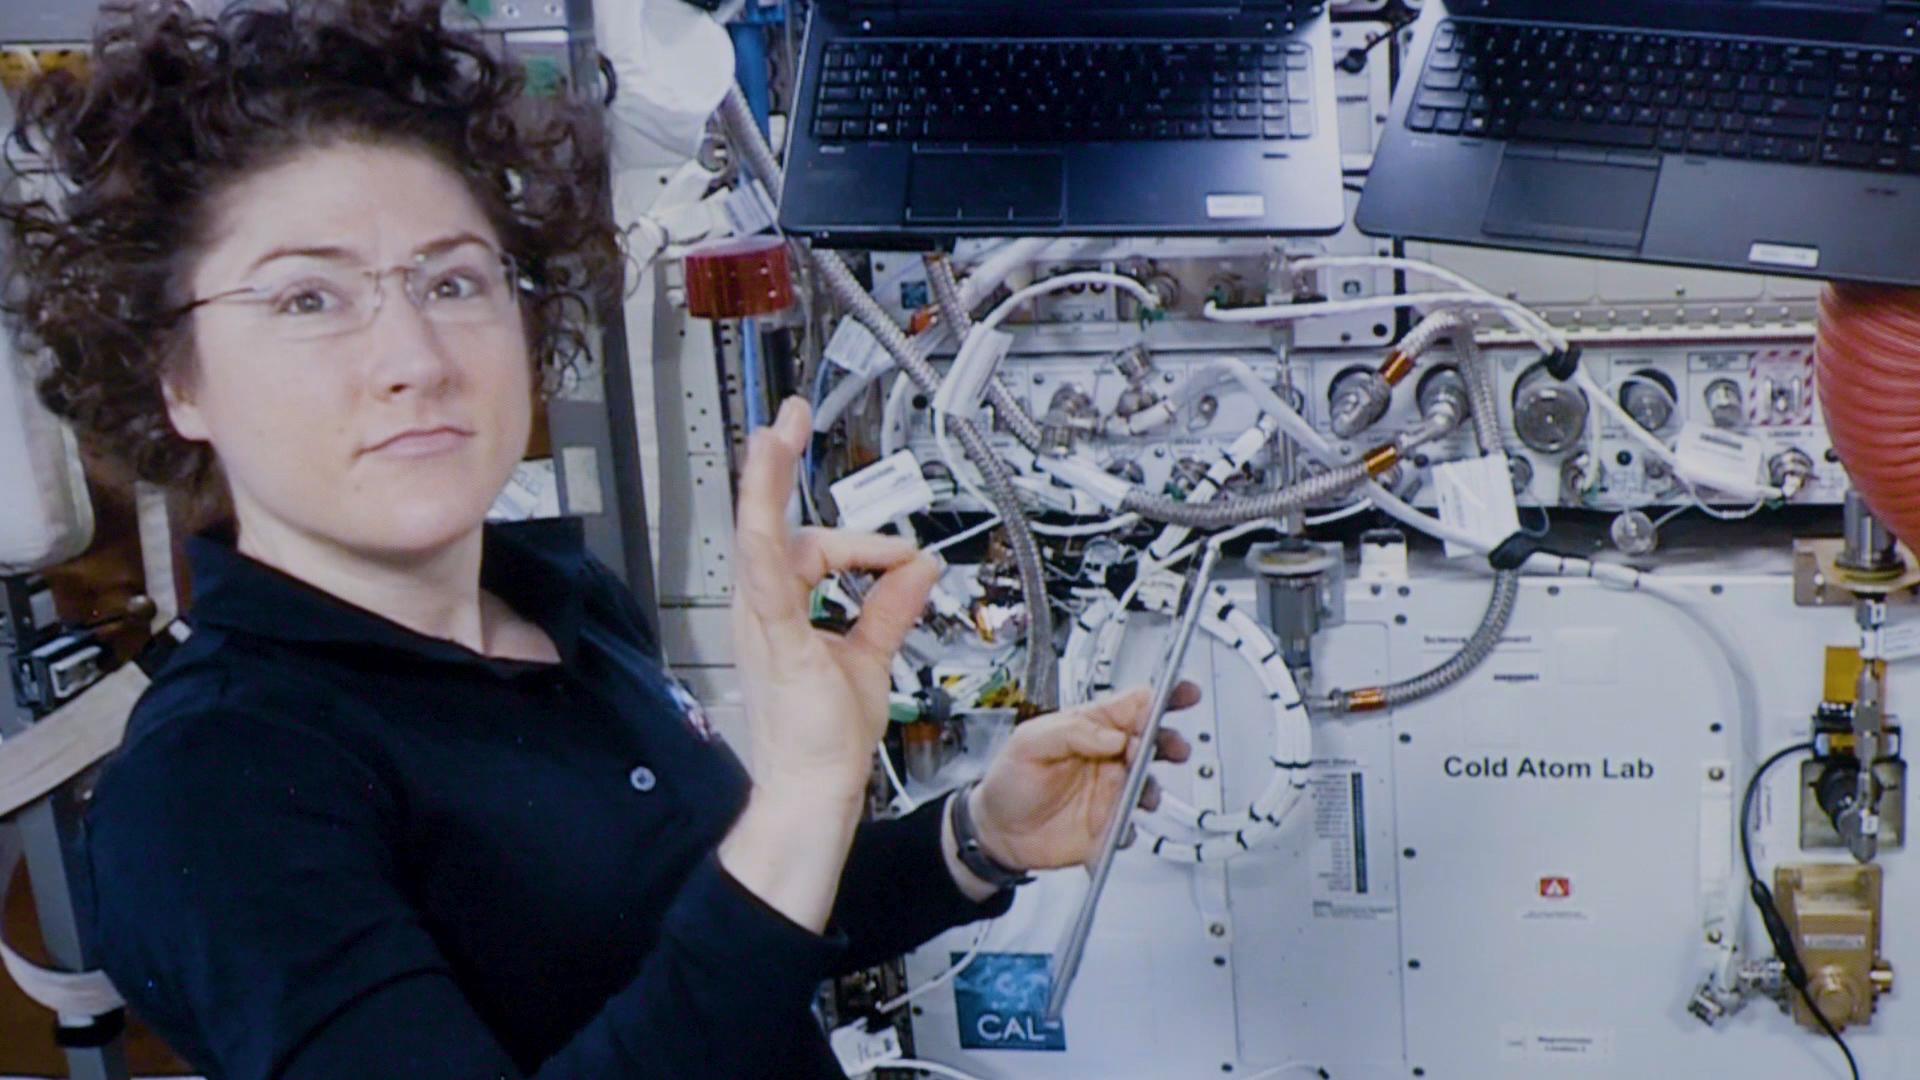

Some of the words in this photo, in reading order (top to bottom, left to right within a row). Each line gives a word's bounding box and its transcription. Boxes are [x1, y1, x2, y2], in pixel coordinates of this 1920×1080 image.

[1443, 755, 1508, 777] Cold
[1516, 757, 1591, 779] Atom
[1602, 758, 1654, 779] Lab
[977, 1013, 1046, 1041] CAL
